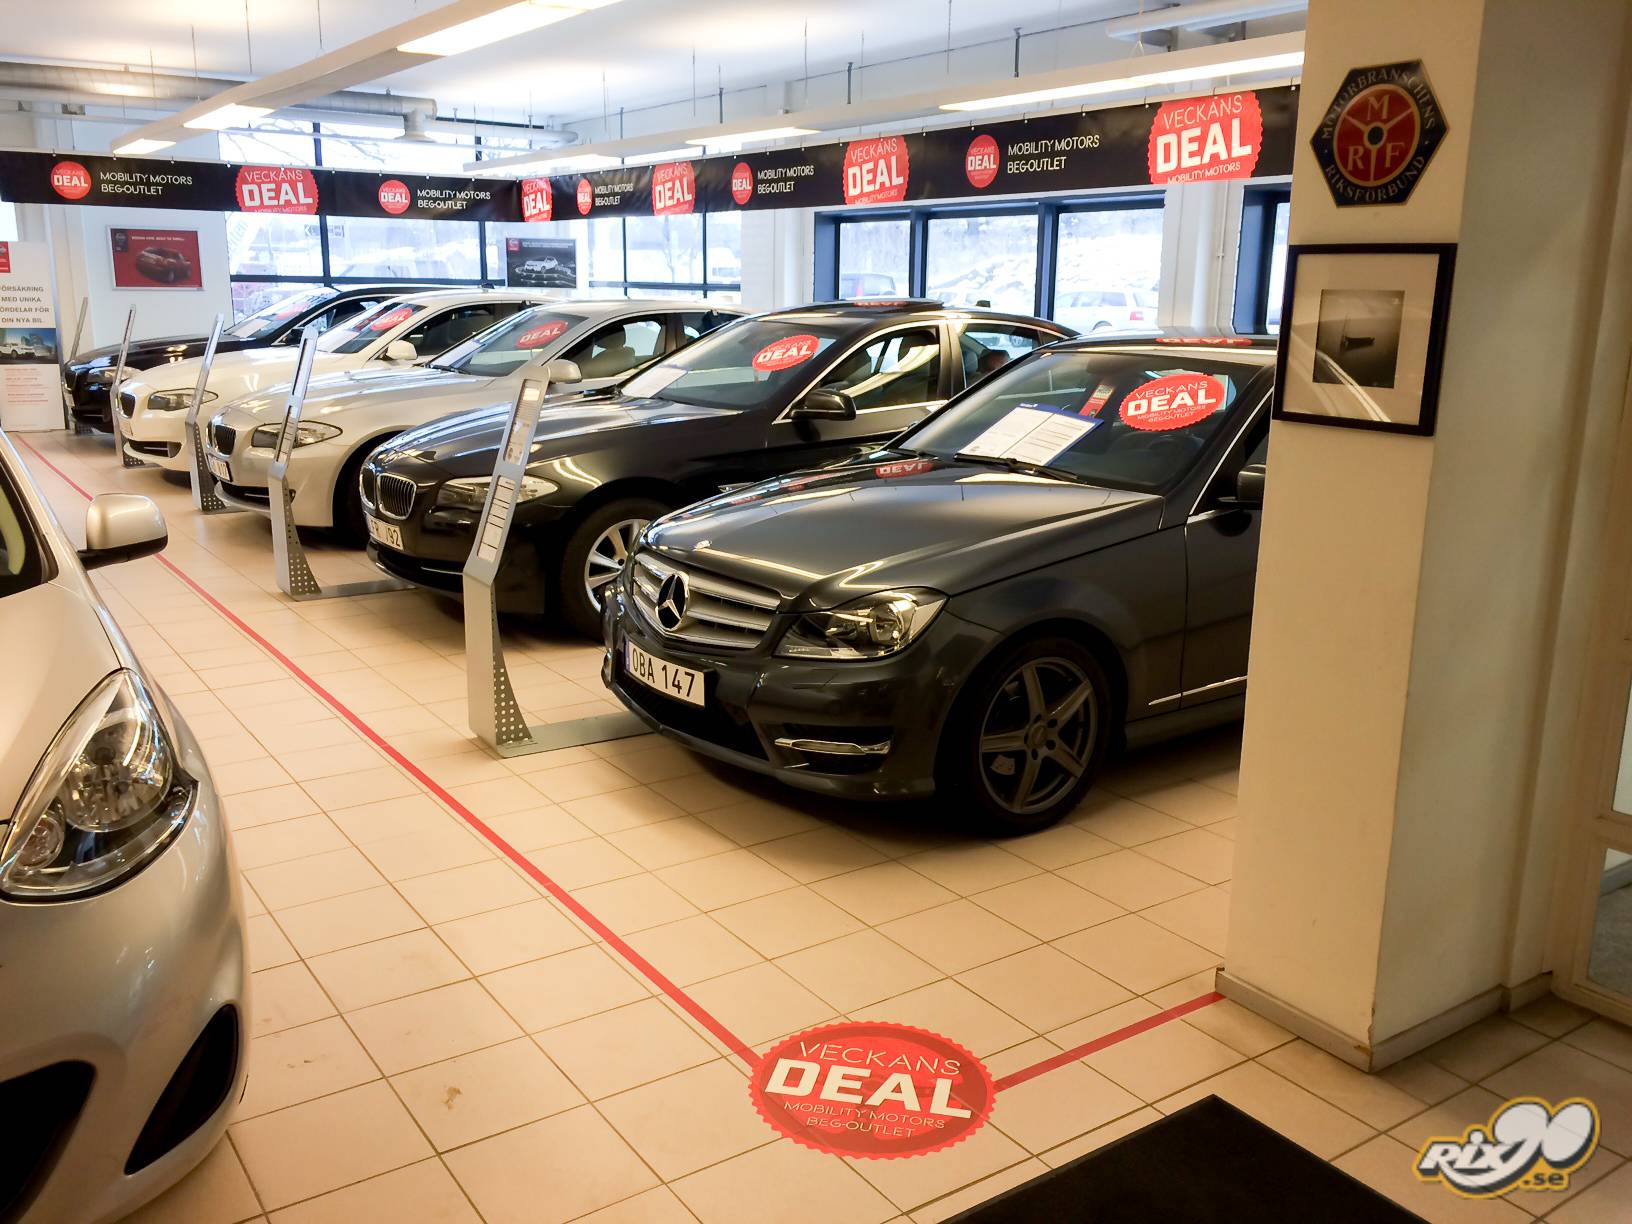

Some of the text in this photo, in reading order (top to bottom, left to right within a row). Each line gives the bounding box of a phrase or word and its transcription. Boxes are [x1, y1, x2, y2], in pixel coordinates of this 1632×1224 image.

[1163, 94, 1243, 129] VECKANS
[1321, 68, 1436, 139] MOTORBRANSCHENS
[1367, 94, 1390, 121] M
[851, 138, 898, 163] VECKANS
[1008, 134, 1100, 156] MOBILITY MOTORS
[1156, 117, 1252, 174] DEAL
[968, 154, 997, 171] DEAL
[1007, 156, 1067, 174] BEG-OUTLET
[1347, 142, 1404, 171] R F
[100, 171, 193, 185] MOBILITY MOTORS
[244, 169, 304, 182] VECKANS
[757, 167, 786, 180] MOBILITY
[786, 165, 815, 178] MOTORS
[848, 156, 904, 197] DEAL
[1205, 161, 1241, 177] MOTORS
[1326, 156, 1425, 201] RIKSFÖRBUND
[53, 174, 89, 188] DEAL
[101, 183, 163, 195] BEG-OUTLET
[732, 178, 752, 191] DEAL
[757, 181, 795, 194] BEG-OUTLET
[242, 181, 313, 207] DEAL
[380, 191, 409, 204] DEAL
[417, 189, 491, 200] MOBILITY MOTORS
[417, 199, 467, 210] BEG-OUTLET
[655, 177, 693, 210] DEAL
[523, 193, 551, 217] DEAL
[519, 327, 560, 344] DEAL
[756, 344, 812, 364] DEAL
[1135, 380, 1209, 400] VECKANS
[1127, 388, 1217, 417] DEAL
[1137, 409, 1172, 420] MOBILITY
[631, 647, 696, 697] OBA 147
[799, 1041, 961, 1076] VECKANS
[764, 1057, 973, 1119] DEAL
[783, 1101, 946, 1129] MOBILITY MOTORS
[806, 1116, 916, 1139] BEG-OUTLET
